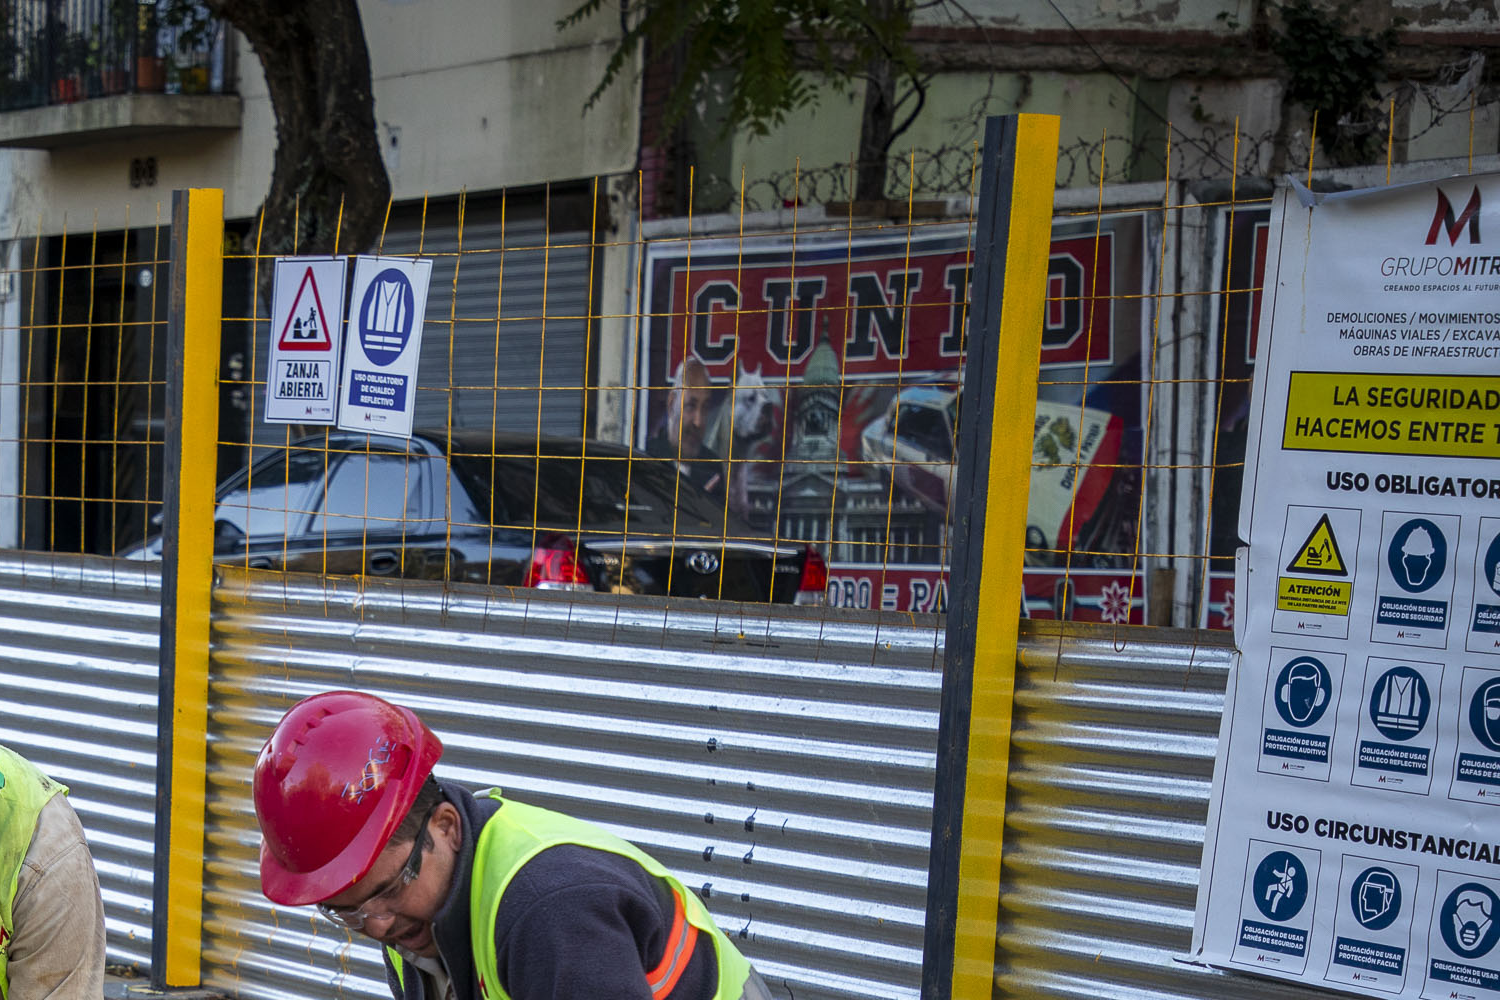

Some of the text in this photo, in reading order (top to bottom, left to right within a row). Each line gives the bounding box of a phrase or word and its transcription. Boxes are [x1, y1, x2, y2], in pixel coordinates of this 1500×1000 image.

[1383, 284, 1420, 292] CREANDO
[1422, 284, 1460, 292] ESPACIOS
[1327, 312, 1407, 324] DEMOLICIONES
[1418, 313, 1500, 324] MOVIMIENTOS
[1339, 327, 1397, 340] MÁQUINAS
[1400, 329, 1440, 340] VIALES
[1353, 345, 1390, 356] OBRAS
[1393, 346, 1409, 357] DE
[286, 363, 319, 378] ZANJA
[354, 373, 404, 386] USO OBLIGATORIO
[279, 381, 324, 398] ABIERTA
[369, 386, 396, 396] CHALECO
[360, 395, 394, 407] REFLECTIVO
[1333, 386, 1500, 410] LA SEGURIDAD
[1295, 416, 1401, 441] HACEMOS
[1408, 420, 1486, 444] ENTRE
[1326, 471, 1500, 499] USO OBLIGATOR
[1288, 584, 1341, 597] ATENCIÓN
[1382, 602, 1417, 612] OBLIGACIÓN
[1410, 613, 1444, 623] SEGURIDAD
[1266, 734, 1301, 744] OBLIGACIÓN
[1310, 740, 1327, 748] USAR
[1265, 742, 1327, 756] PROTECTOR AUDITIVO
[1361, 747, 1399, 757] OBLIGACIÓN
[1360, 755, 1427, 769] CHALECO REFLECTIVO
[1460, 768, 1482, 776] GAFAS
[1267, 810, 1500, 865] USO CIRCUNSTANCIAL
[1244, 925, 1279, 937] OBLIGACIÓN
[1288, 933, 1304, 942] USAR
[1242, 933, 1262, 942] ARNÉS
[1271, 938, 1304, 950] SEGURIDAD
[1338, 944, 1375, 956] OBLIGACIÓN
[1384, 952, 1402, 961] USAR
[1338, 952, 1399, 969] PROTECCIÓN FACIAL
[1434, 962, 1472, 975] OBLIGACIÓN
[1481, 971, 1499, 980] USAR
[1450, 973, 1481, 985] MASCARA
